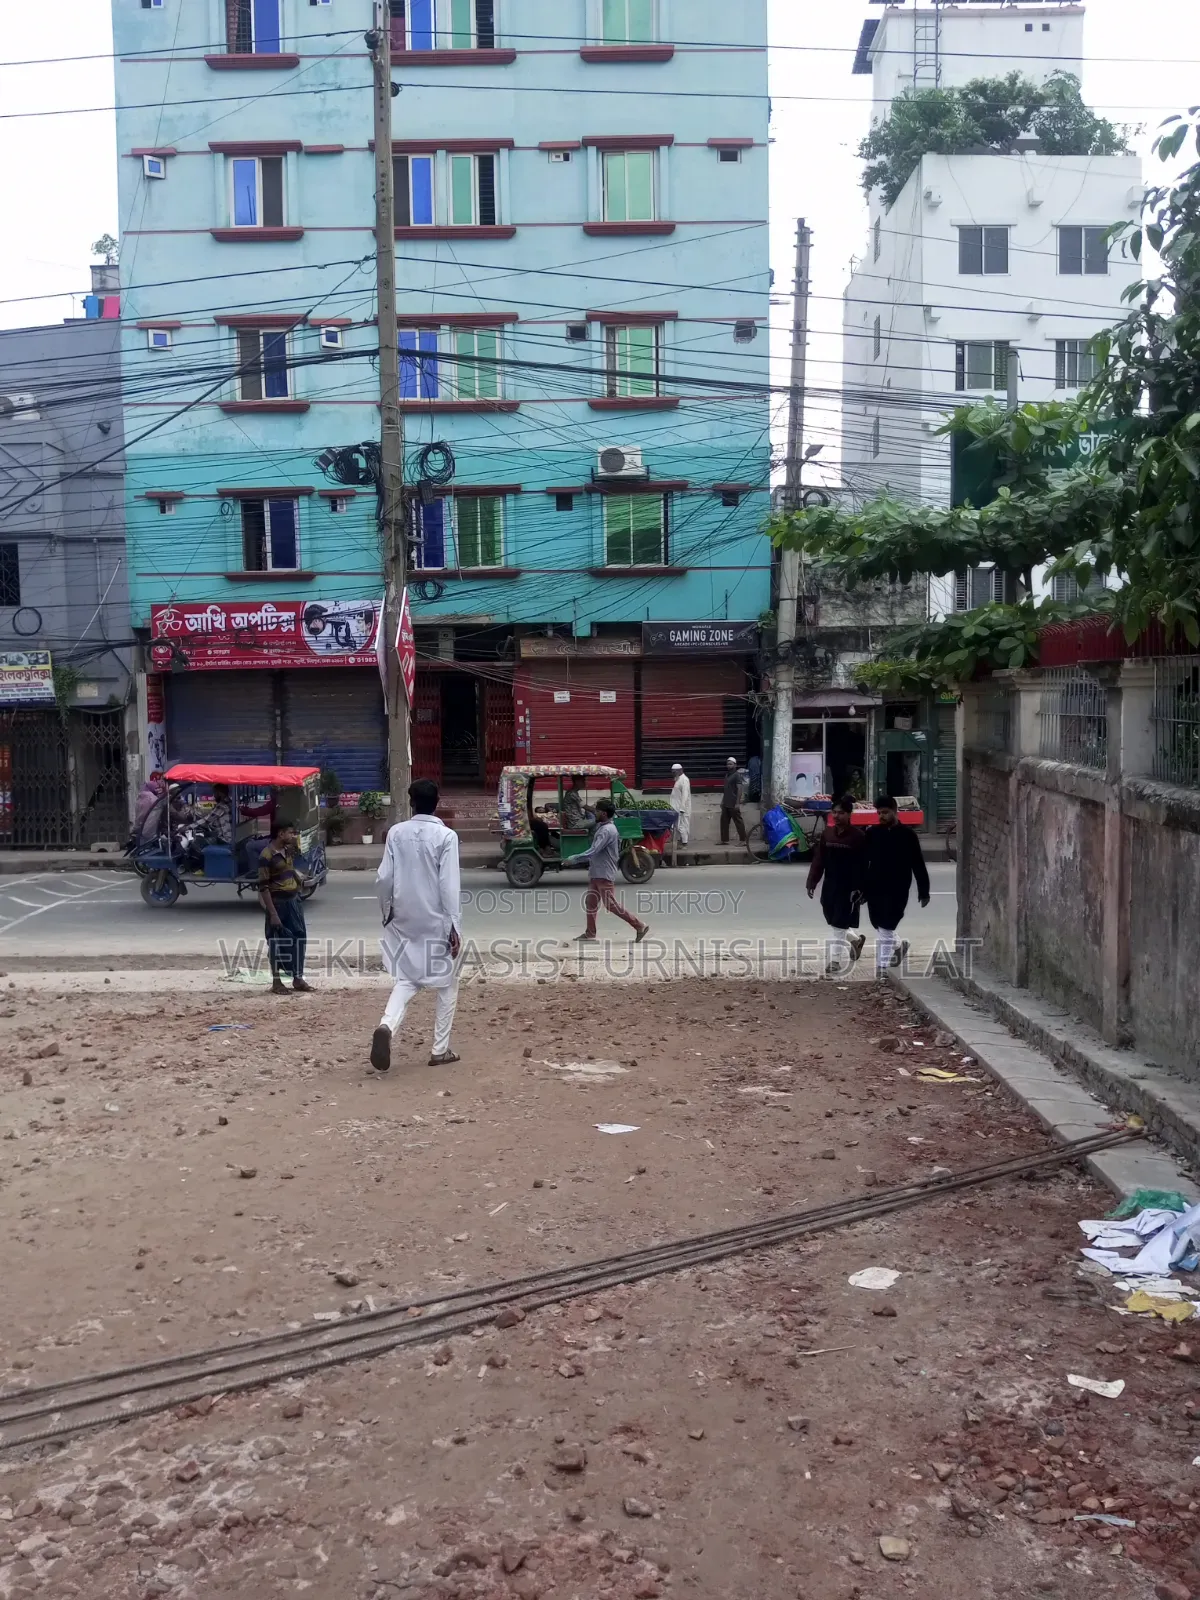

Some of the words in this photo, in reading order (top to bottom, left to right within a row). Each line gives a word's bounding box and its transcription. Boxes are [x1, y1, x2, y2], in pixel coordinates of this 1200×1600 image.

[184, 605, 227, 633] আখি
[230, 602, 296, 633] অপটিক্স
[669, 629, 707, 642] GAMING
[709, 629, 734, 642] ZONE
